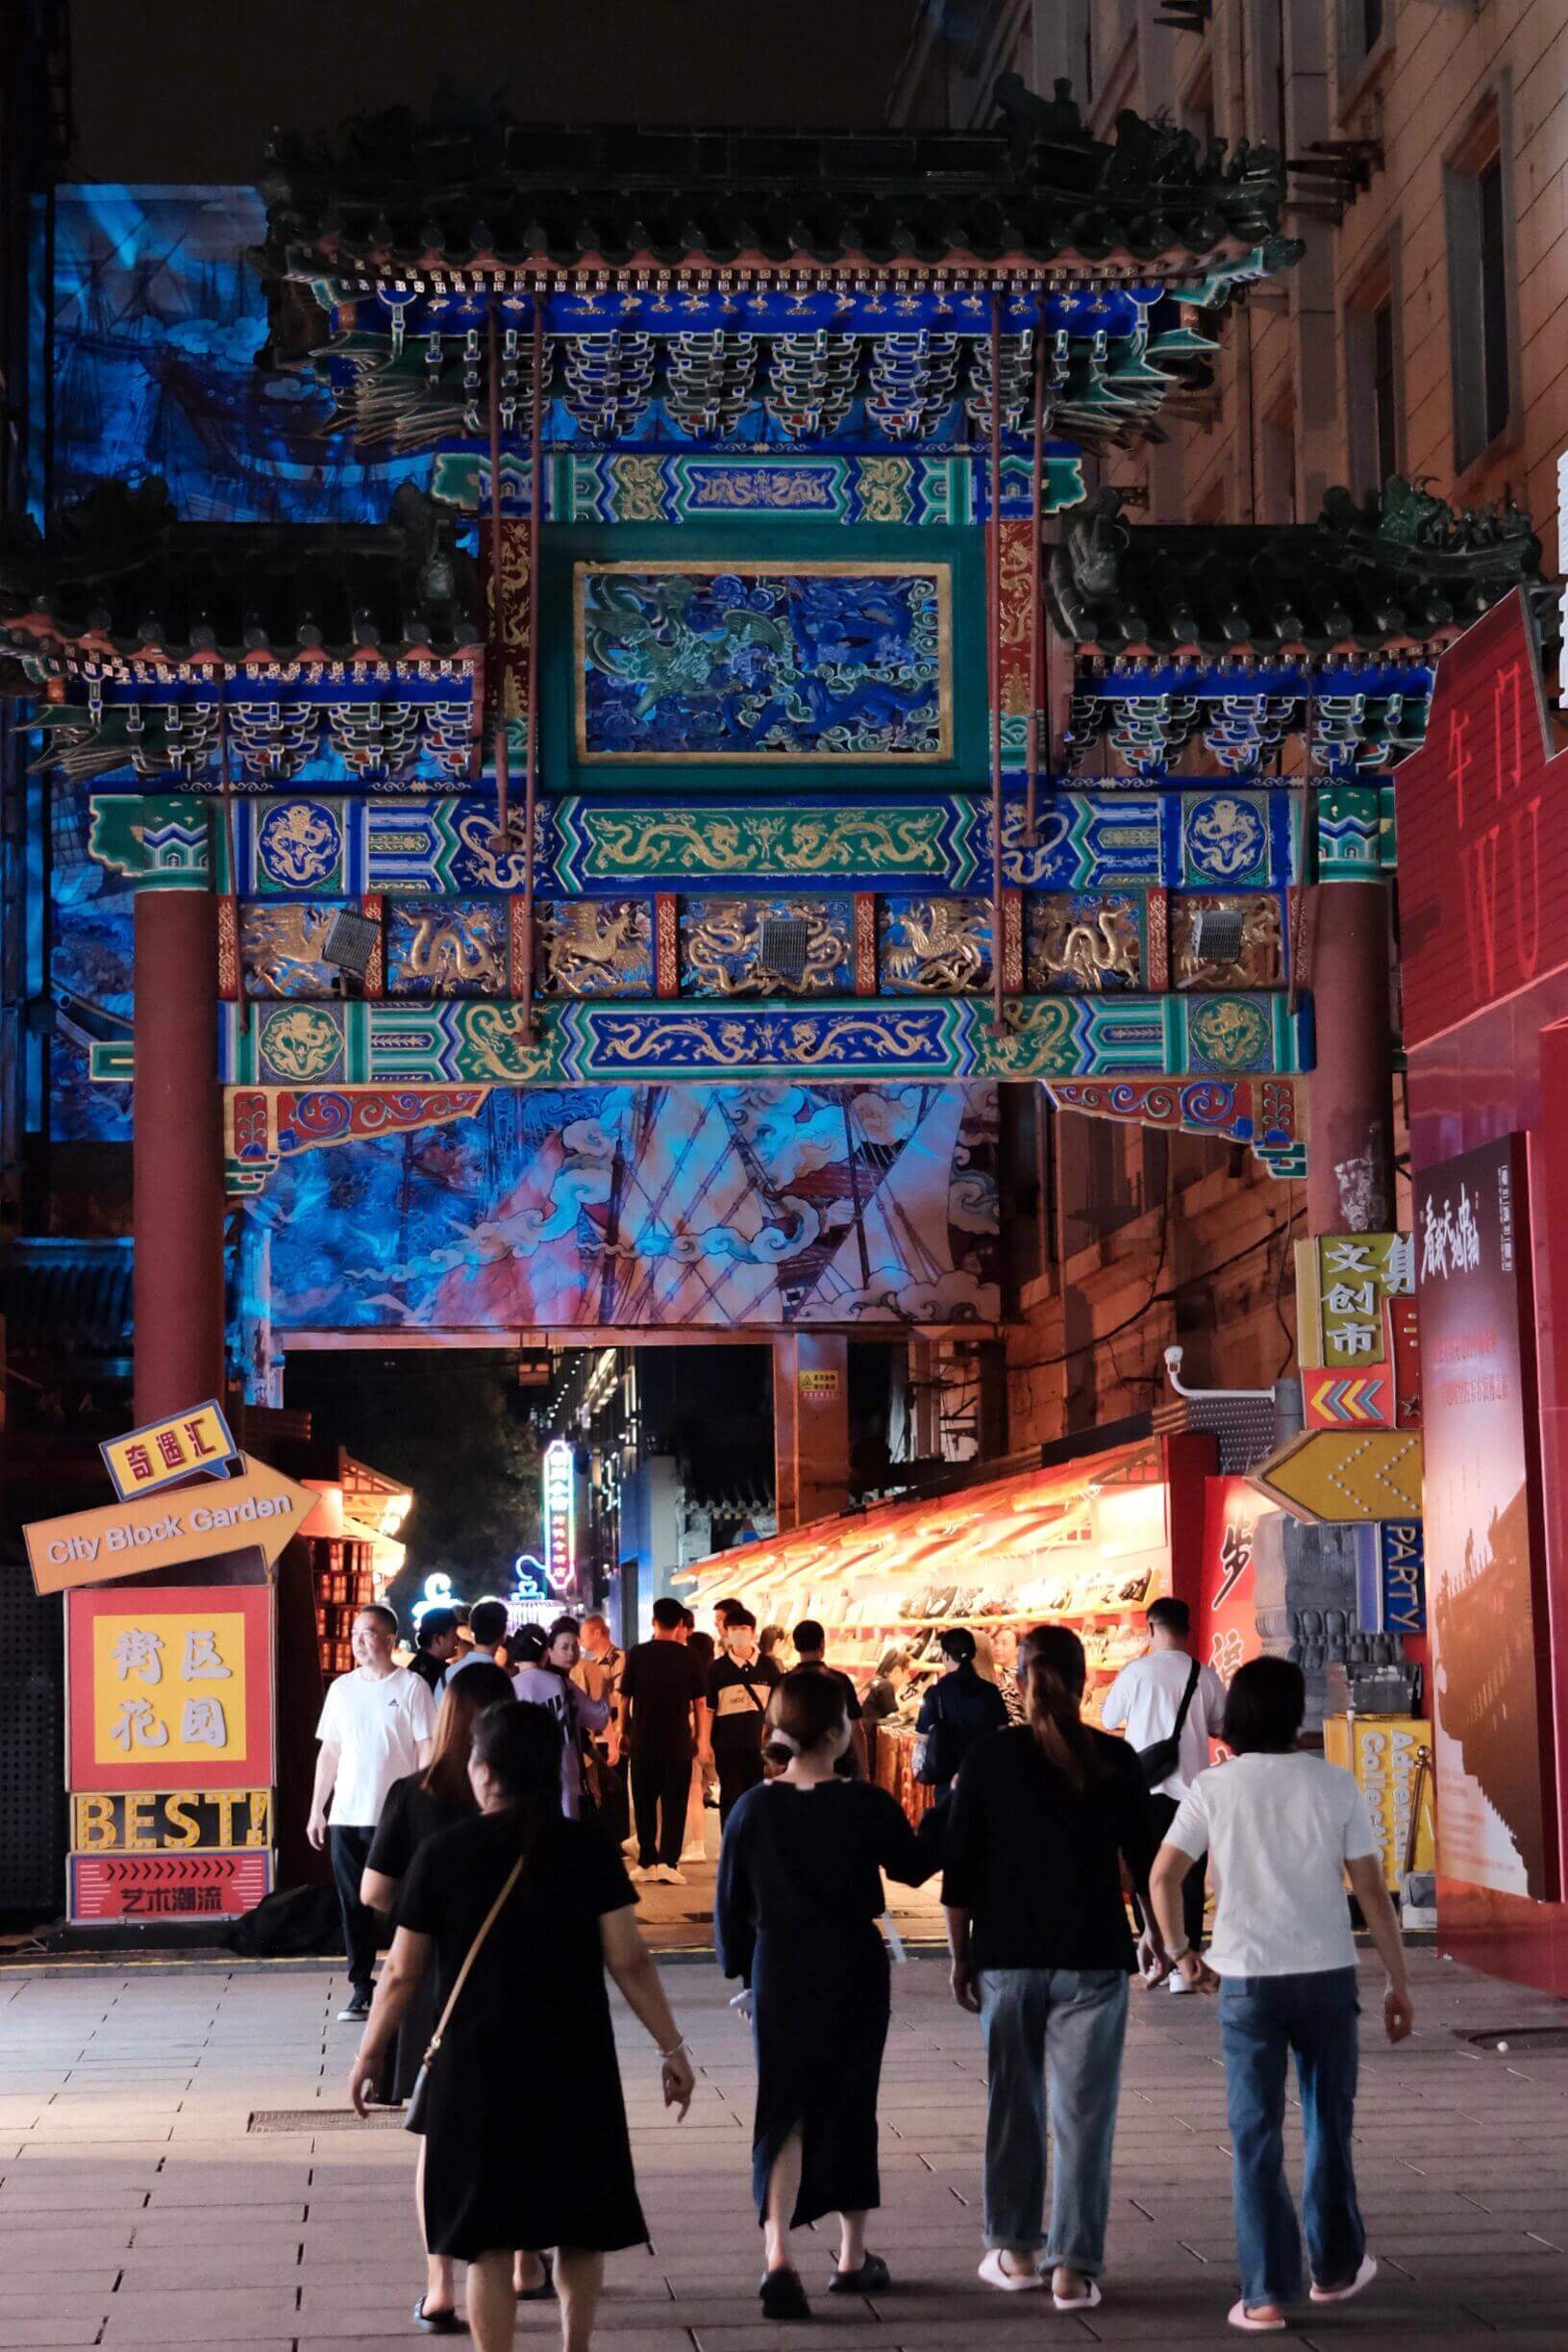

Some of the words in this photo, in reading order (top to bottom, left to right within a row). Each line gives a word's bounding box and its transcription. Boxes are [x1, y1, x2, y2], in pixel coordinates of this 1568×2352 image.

[124, 1417, 216, 1482] 奇遇汇
[47, 1536, 101, 1565] City
[104, 1514, 186, 1552] Block
[190, 1494, 292, 1533] Garden
[1386, 1524, 1421, 1629] PARTY
[111, 1627, 233, 1685] 街区
[111, 1696, 227, 1752] 花园
[77, 1792, 268, 1849] BEST!
[121, 1887, 222, 1912] 艺术潮流
